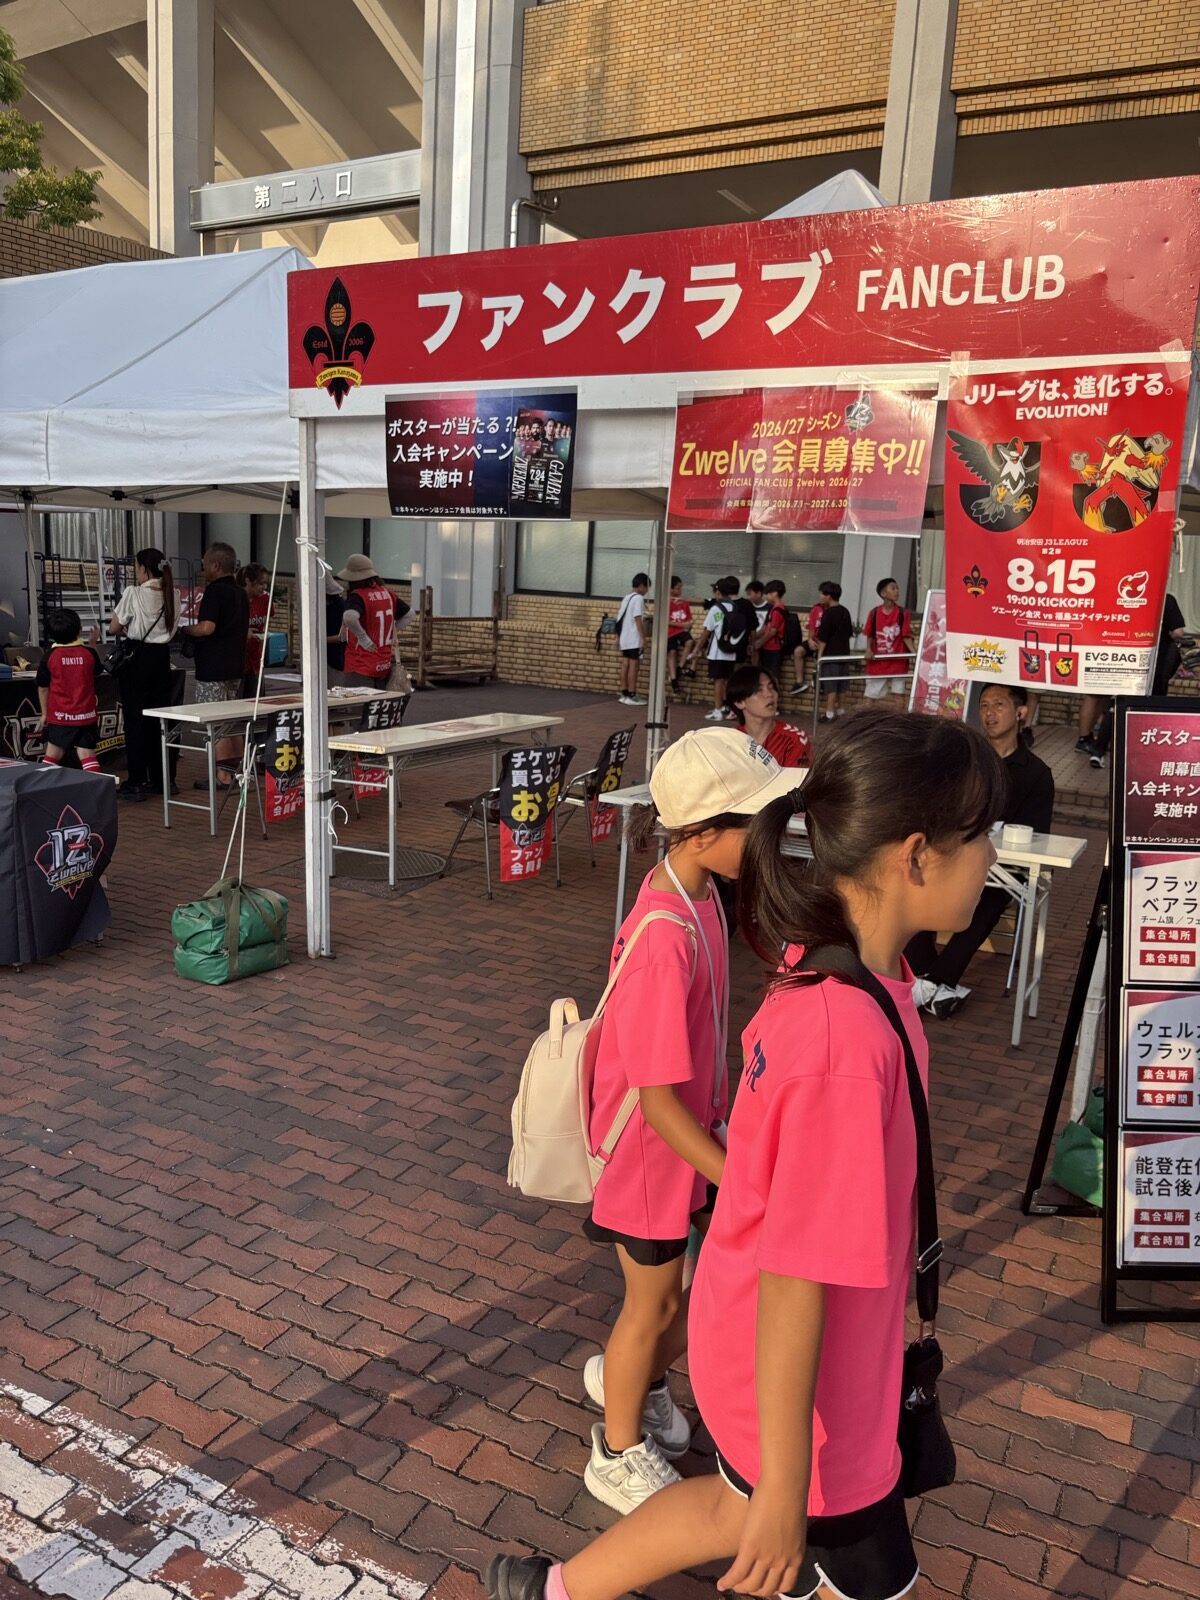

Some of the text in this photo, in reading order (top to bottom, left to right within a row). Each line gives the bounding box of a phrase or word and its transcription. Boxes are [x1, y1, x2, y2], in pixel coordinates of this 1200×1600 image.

[255, 171, 352, 209] 第二入口
[857, 254, 1066, 312] FANCLUB
[418, 248, 833, 354] ファンクラブ
[964, 373, 1173, 405] Jリーグは、進化する。
[1015, 403, 1108, 420] EVOLUTION!
[752, 412, 841, 438] 2026/27 シーズン
[393, 443, 514, 463] 入会キャンペーン
[679, 440, 768, 476] Zwelve
[419, 469, 474, 489] 実施中!
[512, 456, 528, 498] ZWEIGEN
[546, 459, 564, 501] GAMBA
[720, 478, 753, 488] OFFICIAL
[754, 477, 770, 488] FAN
[772, 477, 794, 488] CLUB
[796, 477, 825, 488] Zwelve
[1007, 558, 1096, 594] 8.15
[1007, 594, 1094, 608] 19:00 KICKOFF!
[1111, 653, 1137, 664] BAG
[511, 747, 566, 769] チケット
[1145, 929, 1191, 941] 集合場所
[1145, 953, 1190, 965] 集合時間
[1137, 1021, 1200, 1039] ウェル
[1137, 1043, 1200, 1060] フラッ
[1143, 1070, 1188, 1081] 集合場所
[1143, 1092, 1188, 1104] 集合時間
[1139, 1211, 1185, 1222] 集合場所
[1139, 1235, 1185, 1246] 集合時間
